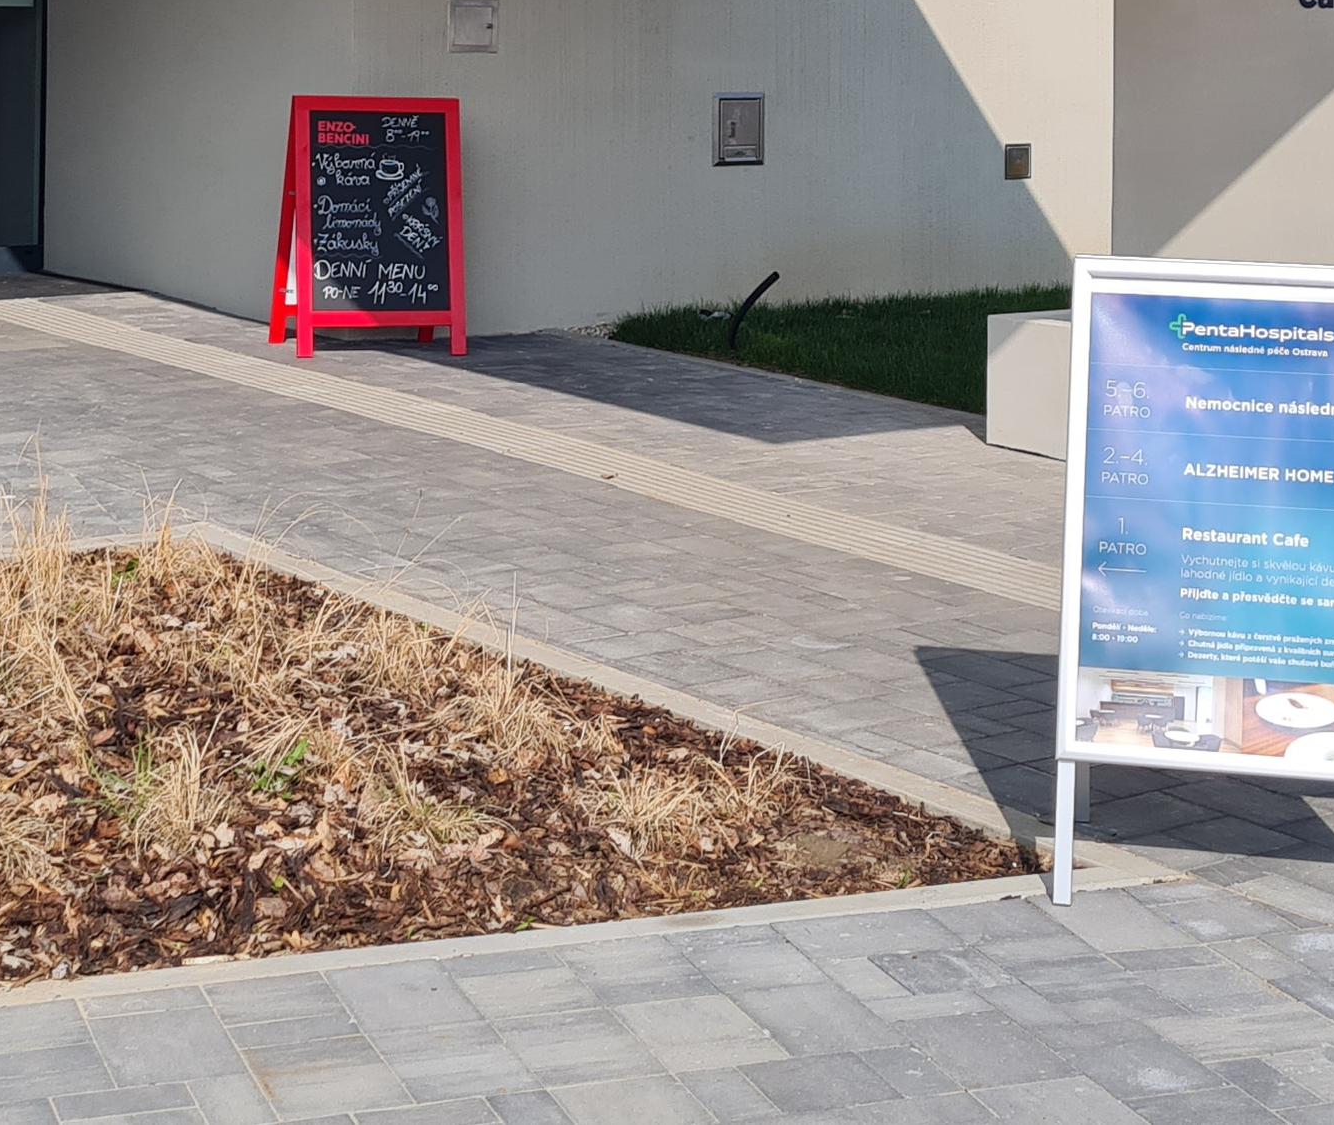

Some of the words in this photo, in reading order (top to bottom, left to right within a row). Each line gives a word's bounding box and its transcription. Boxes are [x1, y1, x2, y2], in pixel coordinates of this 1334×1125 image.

[318, 120, 355, 133] ENZO
[381, 115, 419, 128] DENNĚ
[318, 132, 369, 145] BENCINI
[336, 170, 370, 185] káva
[318, 195, 371, 215] Domácí
[317, 232, 379, 256] Zákusky
[314, 259, 372, 280] DENNÍ
[378, 263, 426, 279] MENU
[323, 286, 361, 299] PO-NE
[1182, 322, 1334, 342] PentaHospitals
[1182, 343, 1221, 353] Centrum
[1224, 344, 1265, 355] následné
[1267, 346, 1289, 356] péče
[1292, 348, 1328, 357] Ostrava
[1103, 404, 1151, 418] PATRO
[1185, 396, 1274, 413] Nemocnice
[1101, 471, 1149, 485] PATRO
[1183, 463, 1280, 481] ALZHEIMER
[1285, 469, 1334, 483] HOME
[1182, 527, 1268, 544] Restaurant
[1272, 533, 1309, 548] Cafe
[1099, 541, 1147, 555] PATRO
[1181, 555, 1248, 569] Vychutnejte
[1252, 559, 1260, 568] si
[1264, 559, 1307, 571] skvělou
[1180, 568, 1226, 581] lahodné
[1228, 572, 1253, 583] jídlo
[1266, 574, 1318, 587] vynikající
[1180, 587, 1219, 601] Přijďte
[1222, 593, 1229, 601] a
[1232, 590, 1297, 605] přesvědčte
[1300, 597, 1314, 606] se
